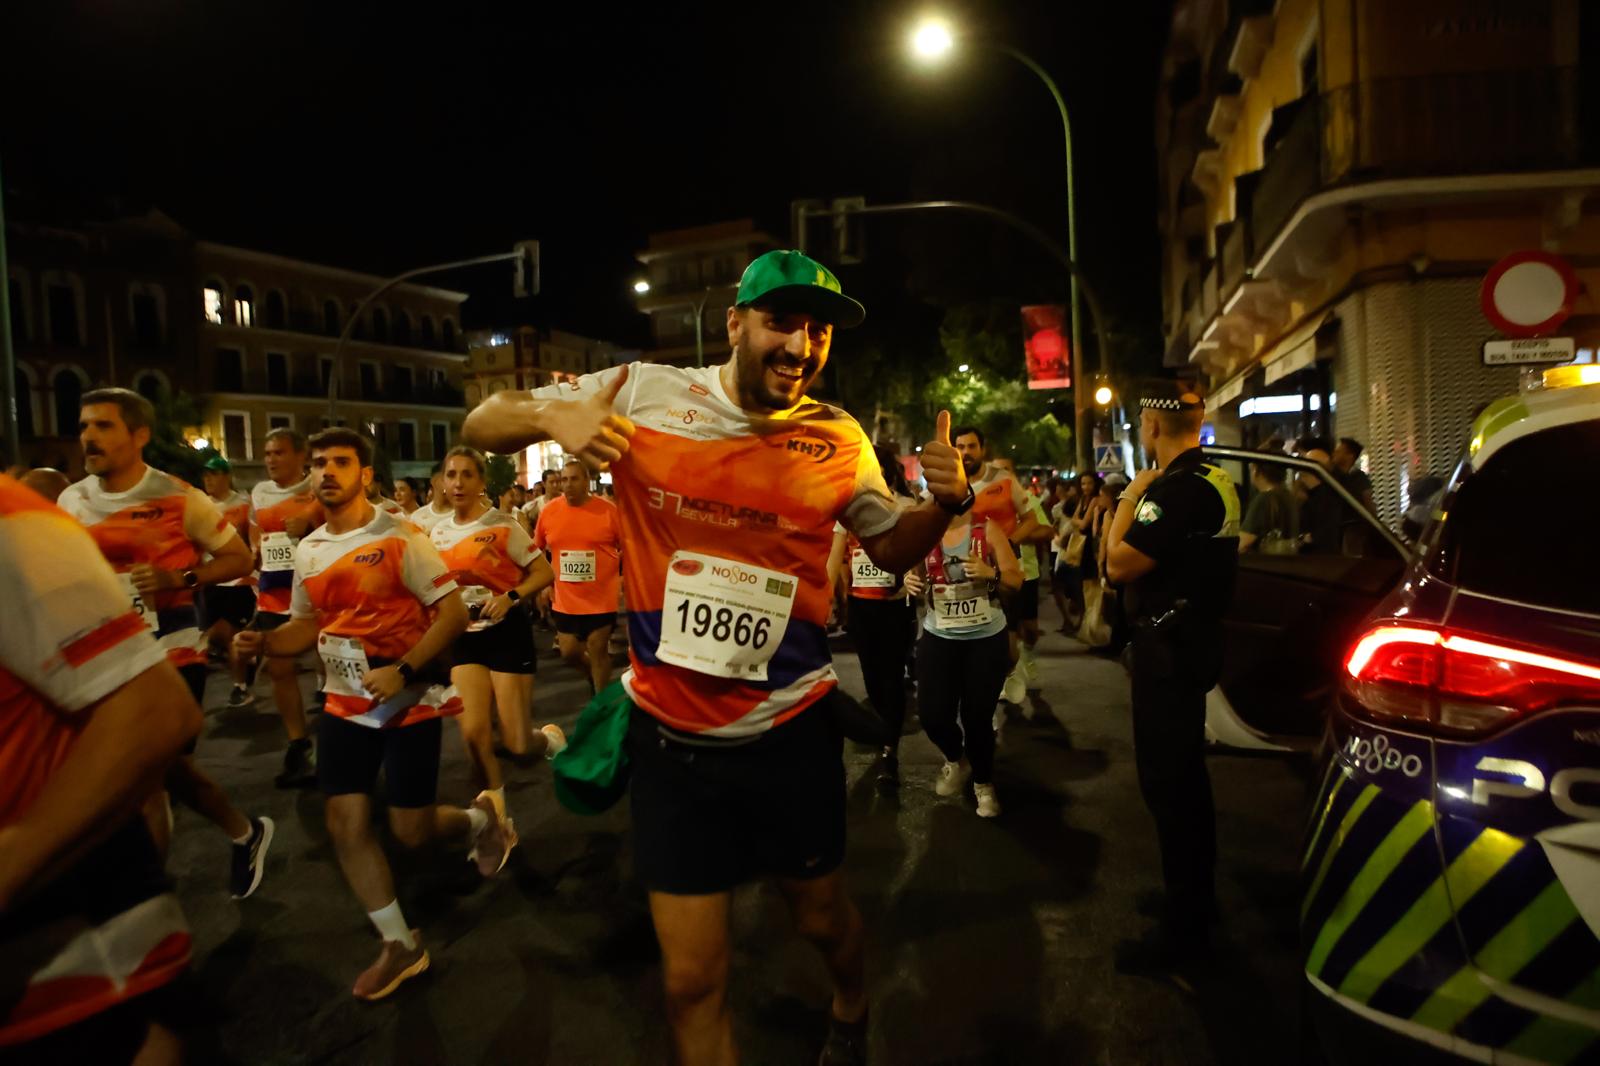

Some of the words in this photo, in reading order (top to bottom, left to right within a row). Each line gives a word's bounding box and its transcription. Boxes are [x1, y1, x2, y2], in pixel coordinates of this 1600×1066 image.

[648, 487, 682, 515] 37
[681, 507, 738, 529] SEVILLA
[266, 547, 292, 561] 7095
[564, 563, 591, 574] 10222
[944, 599, 978, 616] 7707
[677, 599, 771, 650] 19866
